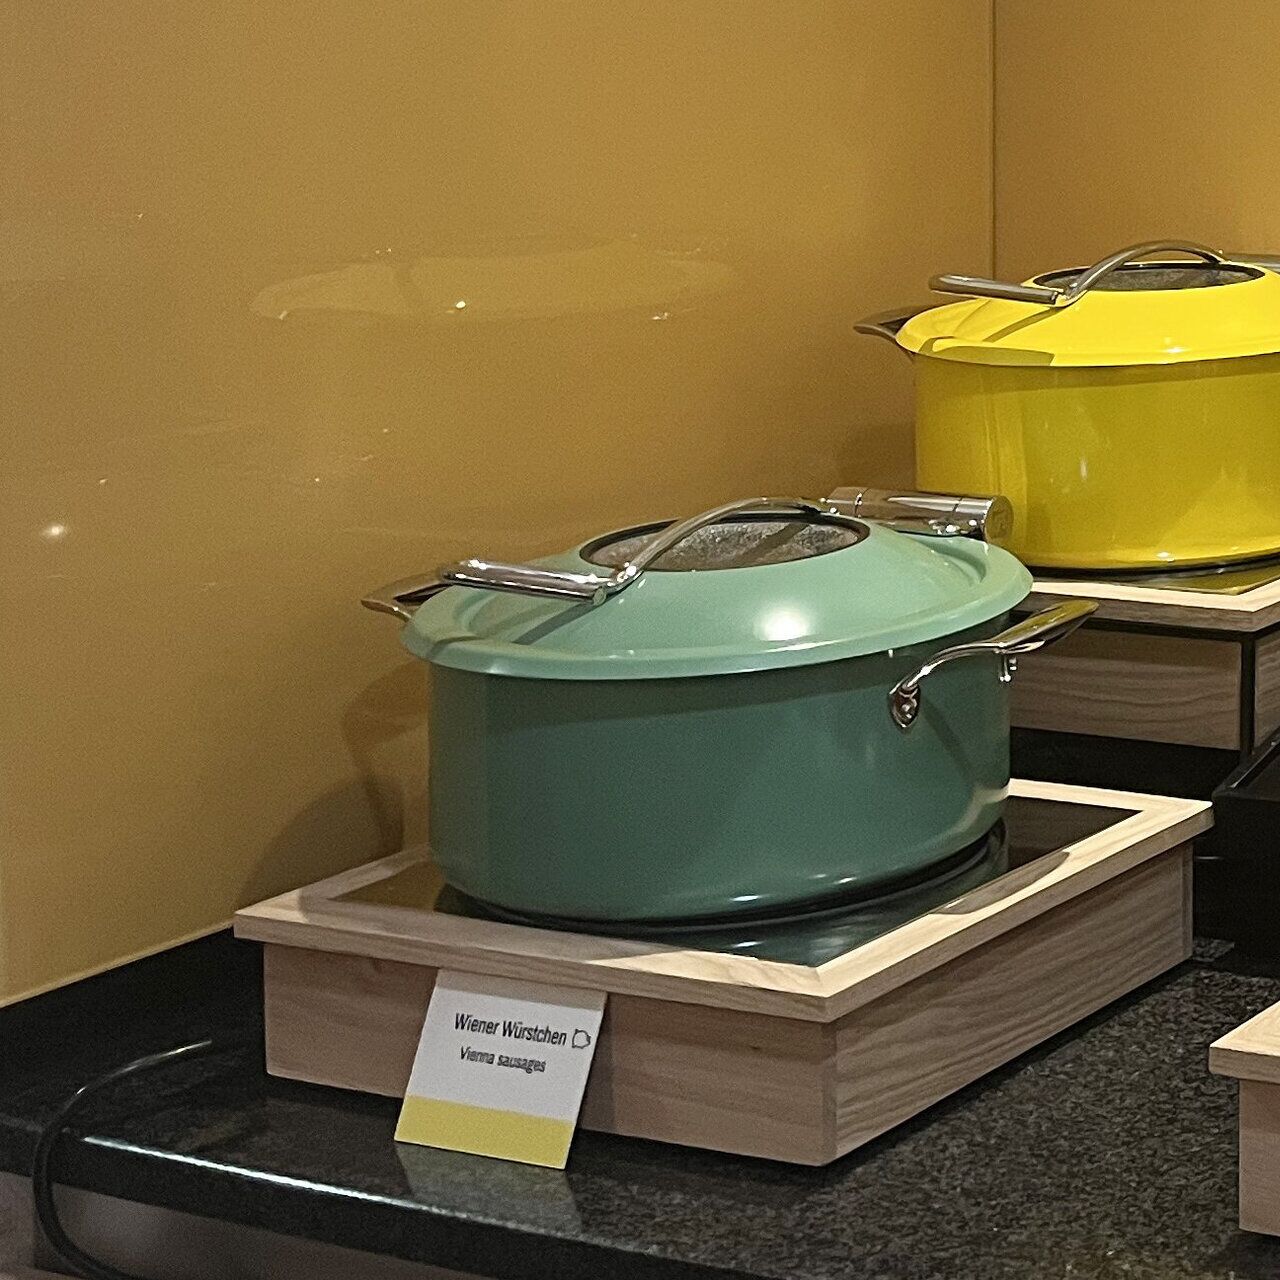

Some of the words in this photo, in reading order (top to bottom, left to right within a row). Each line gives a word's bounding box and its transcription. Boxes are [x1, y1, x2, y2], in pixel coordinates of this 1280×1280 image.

[454, 1012, 500, 1036] Wiener
[501, 1020, 568, 1046] Würstchen
[460, 1046, 494, 1065] Vienna
[496, 1054, 547, 1074] sausages
